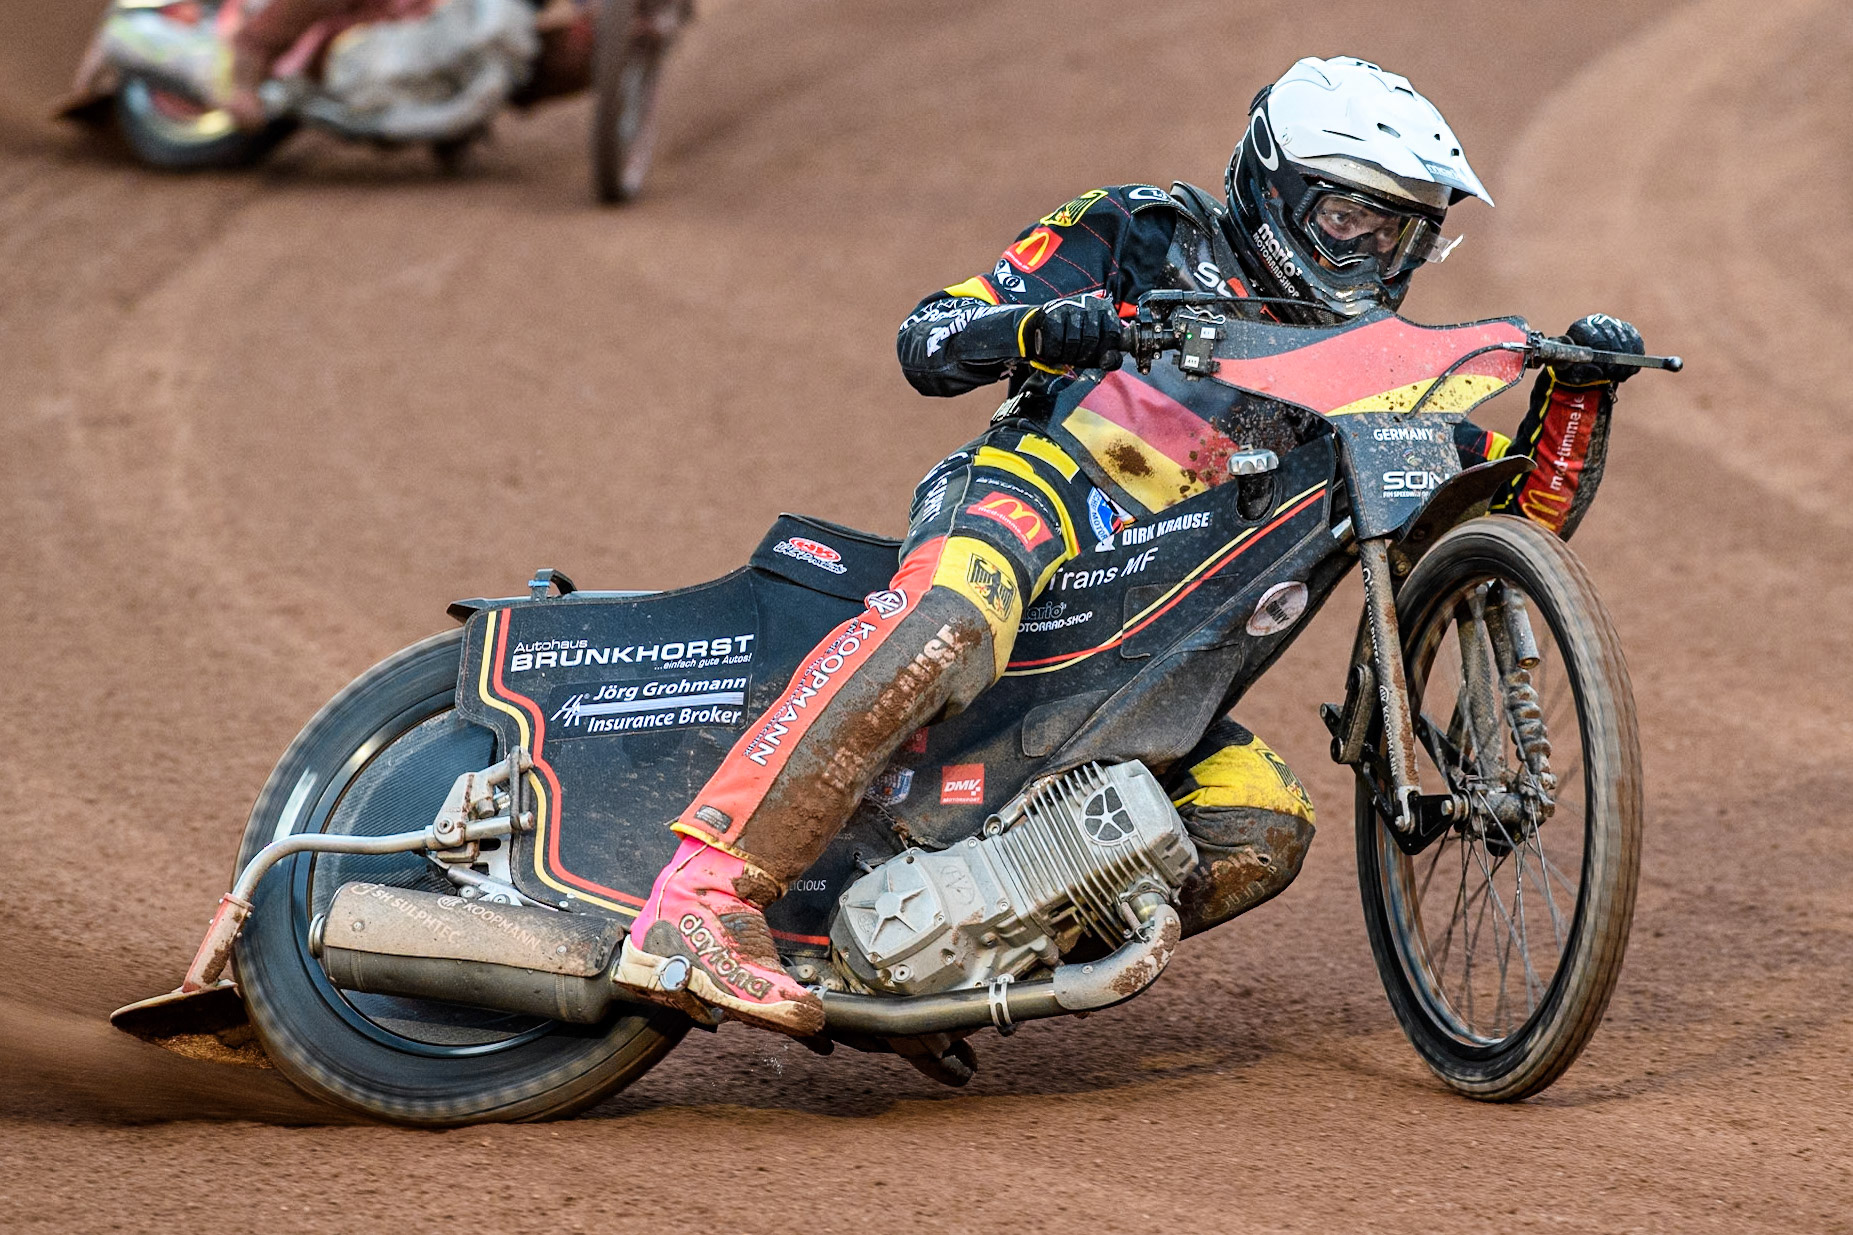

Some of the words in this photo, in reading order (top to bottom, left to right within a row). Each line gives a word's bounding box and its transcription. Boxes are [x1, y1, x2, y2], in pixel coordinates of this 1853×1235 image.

[1252, 231, 1300, 298] MOTORRADSHOP
[1373, 428, 1434, 441] GERMANY
[1382, 470, 1450, 491] SON
[1092, 511, 1108, 540] MOTOR
[1122, 525, 1157, 546] DIRK
[1157, 511, 1211, 537] KRAUSE
[1120, 547, 1158, 578] MF
[1017, 611, 1093, 632] OTORRAD-SHOP
[1024, 601, 1067, 620] ario's
[510, 634, 754, 672] BRUNKHORST
[513, 639, 588, 654] Autohaus
[698, 657, 719, 669] gute
[722, 653, 752, 664] Autos!
[593, 684, 639, 702] Jörg
[642, 676, 747, 697] Grohmann
[749, 621, 877, 767] KOOPMANN
[587, 715, 673, 733] Insurance
[678, 706, 741, 725] Broker
[1382, 705, 1398, 777] KOOPMANN
[944, 779, 981, 793] DMV
[372, 888, 394, 903] SH
[391, 898, 461, 944] SULPHTEC
[462, 901, 542, 949] KOOPMANN
[678, 913, 775, 1001] daytona
